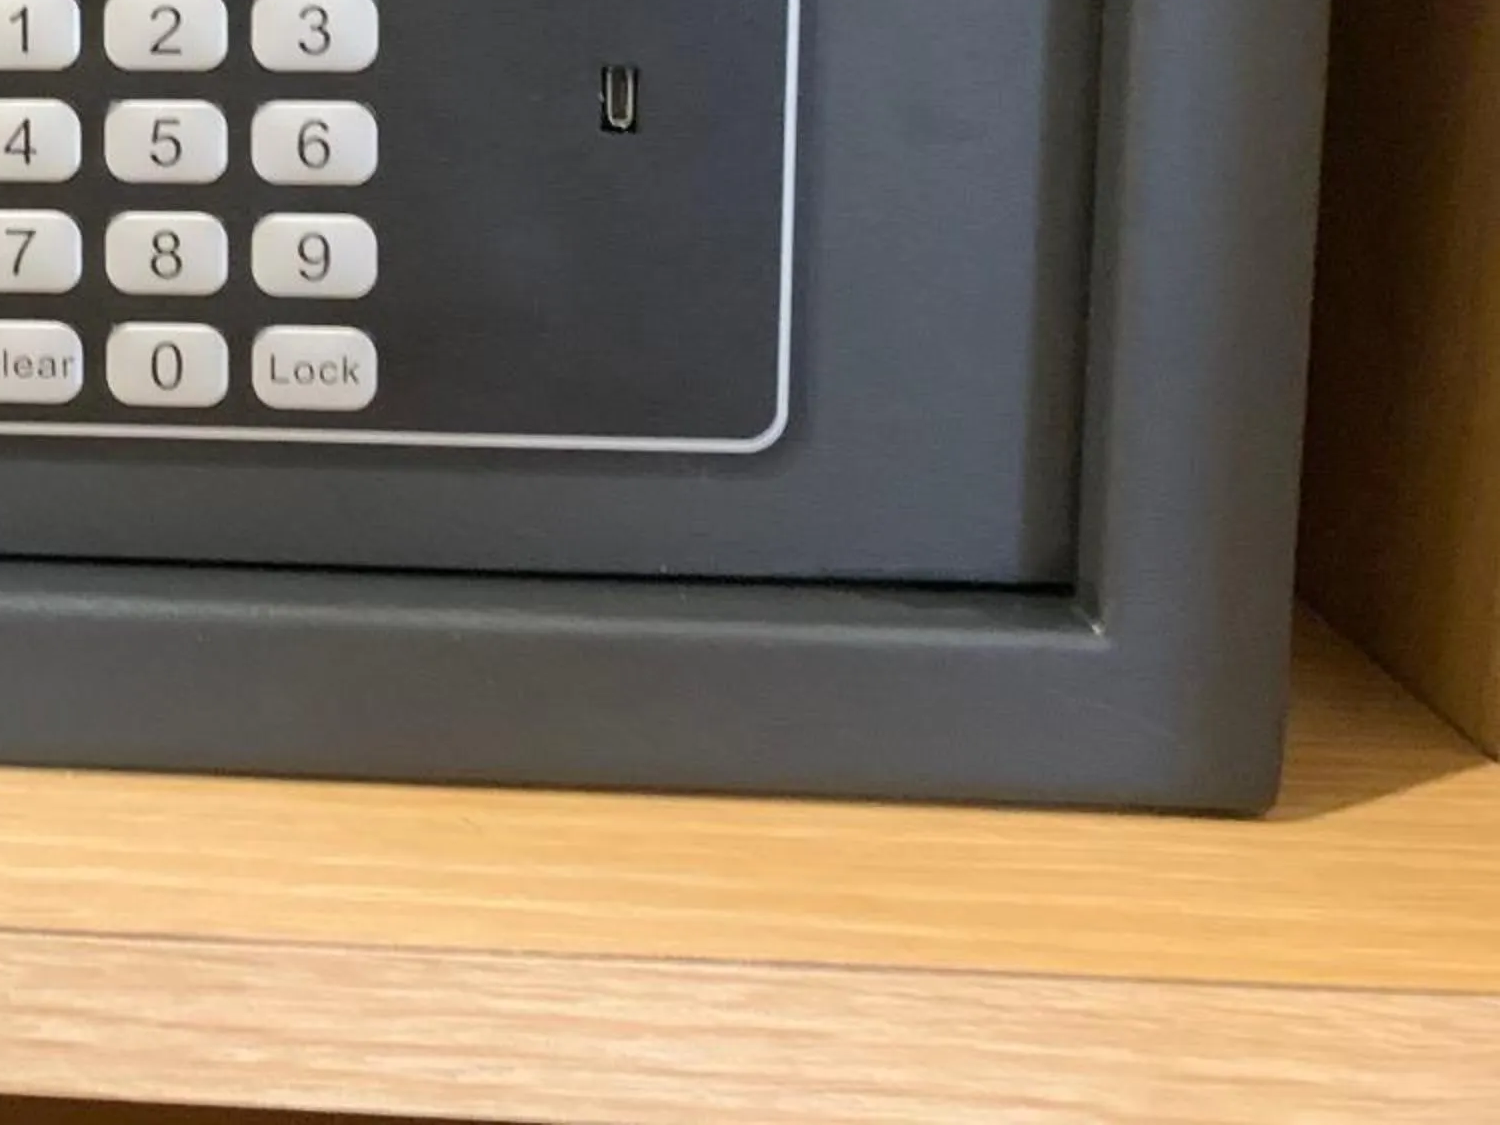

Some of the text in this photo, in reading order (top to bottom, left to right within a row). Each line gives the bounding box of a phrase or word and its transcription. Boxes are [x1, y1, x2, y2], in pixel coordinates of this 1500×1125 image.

[8, 5, 30, 54] 1
[149, 5, 182, 56] 2
[297, 5, 332, 57] 3
[3, 117, 38, 166] 4
[149, 118, 183, 168] 5
[296, 119, 332, 169] 6
[5, 228, 37, 277] 7
[149, 229, 184, 280] 8
[297, 232, 332, 282] 9
[150, 341, 184, 391] 0
[269, 353, 361, 386] Lock
